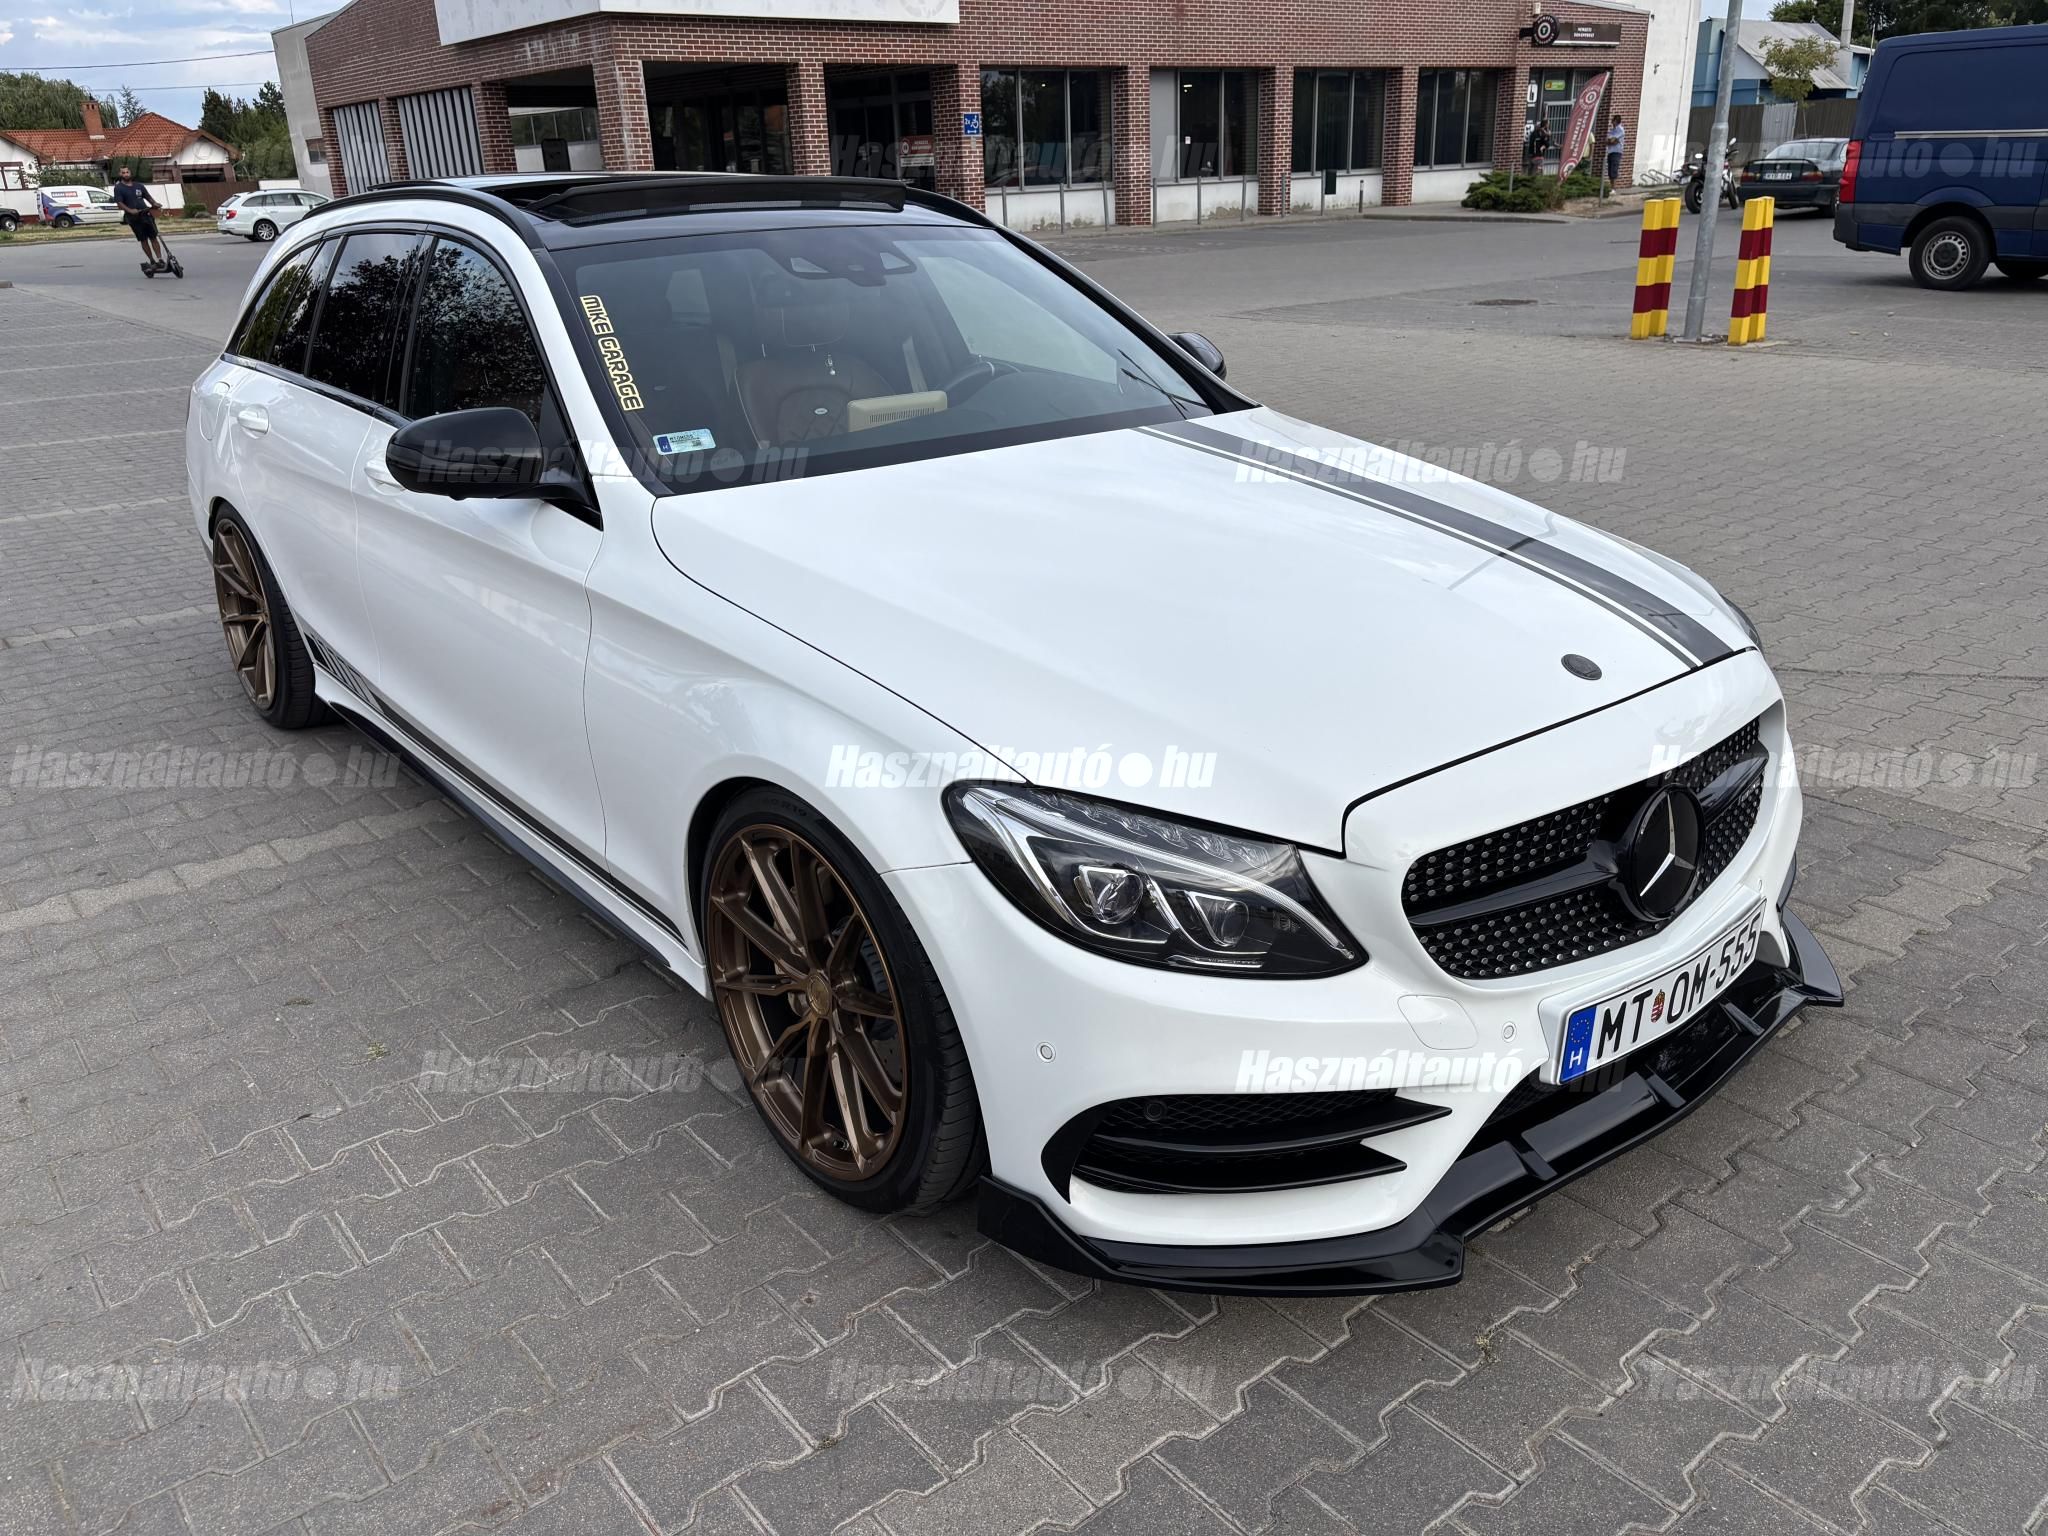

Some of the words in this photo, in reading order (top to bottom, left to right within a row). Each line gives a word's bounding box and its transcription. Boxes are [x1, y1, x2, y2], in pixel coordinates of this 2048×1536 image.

[580, 295, 614, 335] MIKE
[598, 336, 645, 411] GARAGE
[1597, 989, 1653, 1060] MT
[1666, 911, 1761, 1024] OM-555
[1568, 1047, 1584, 1070] H
